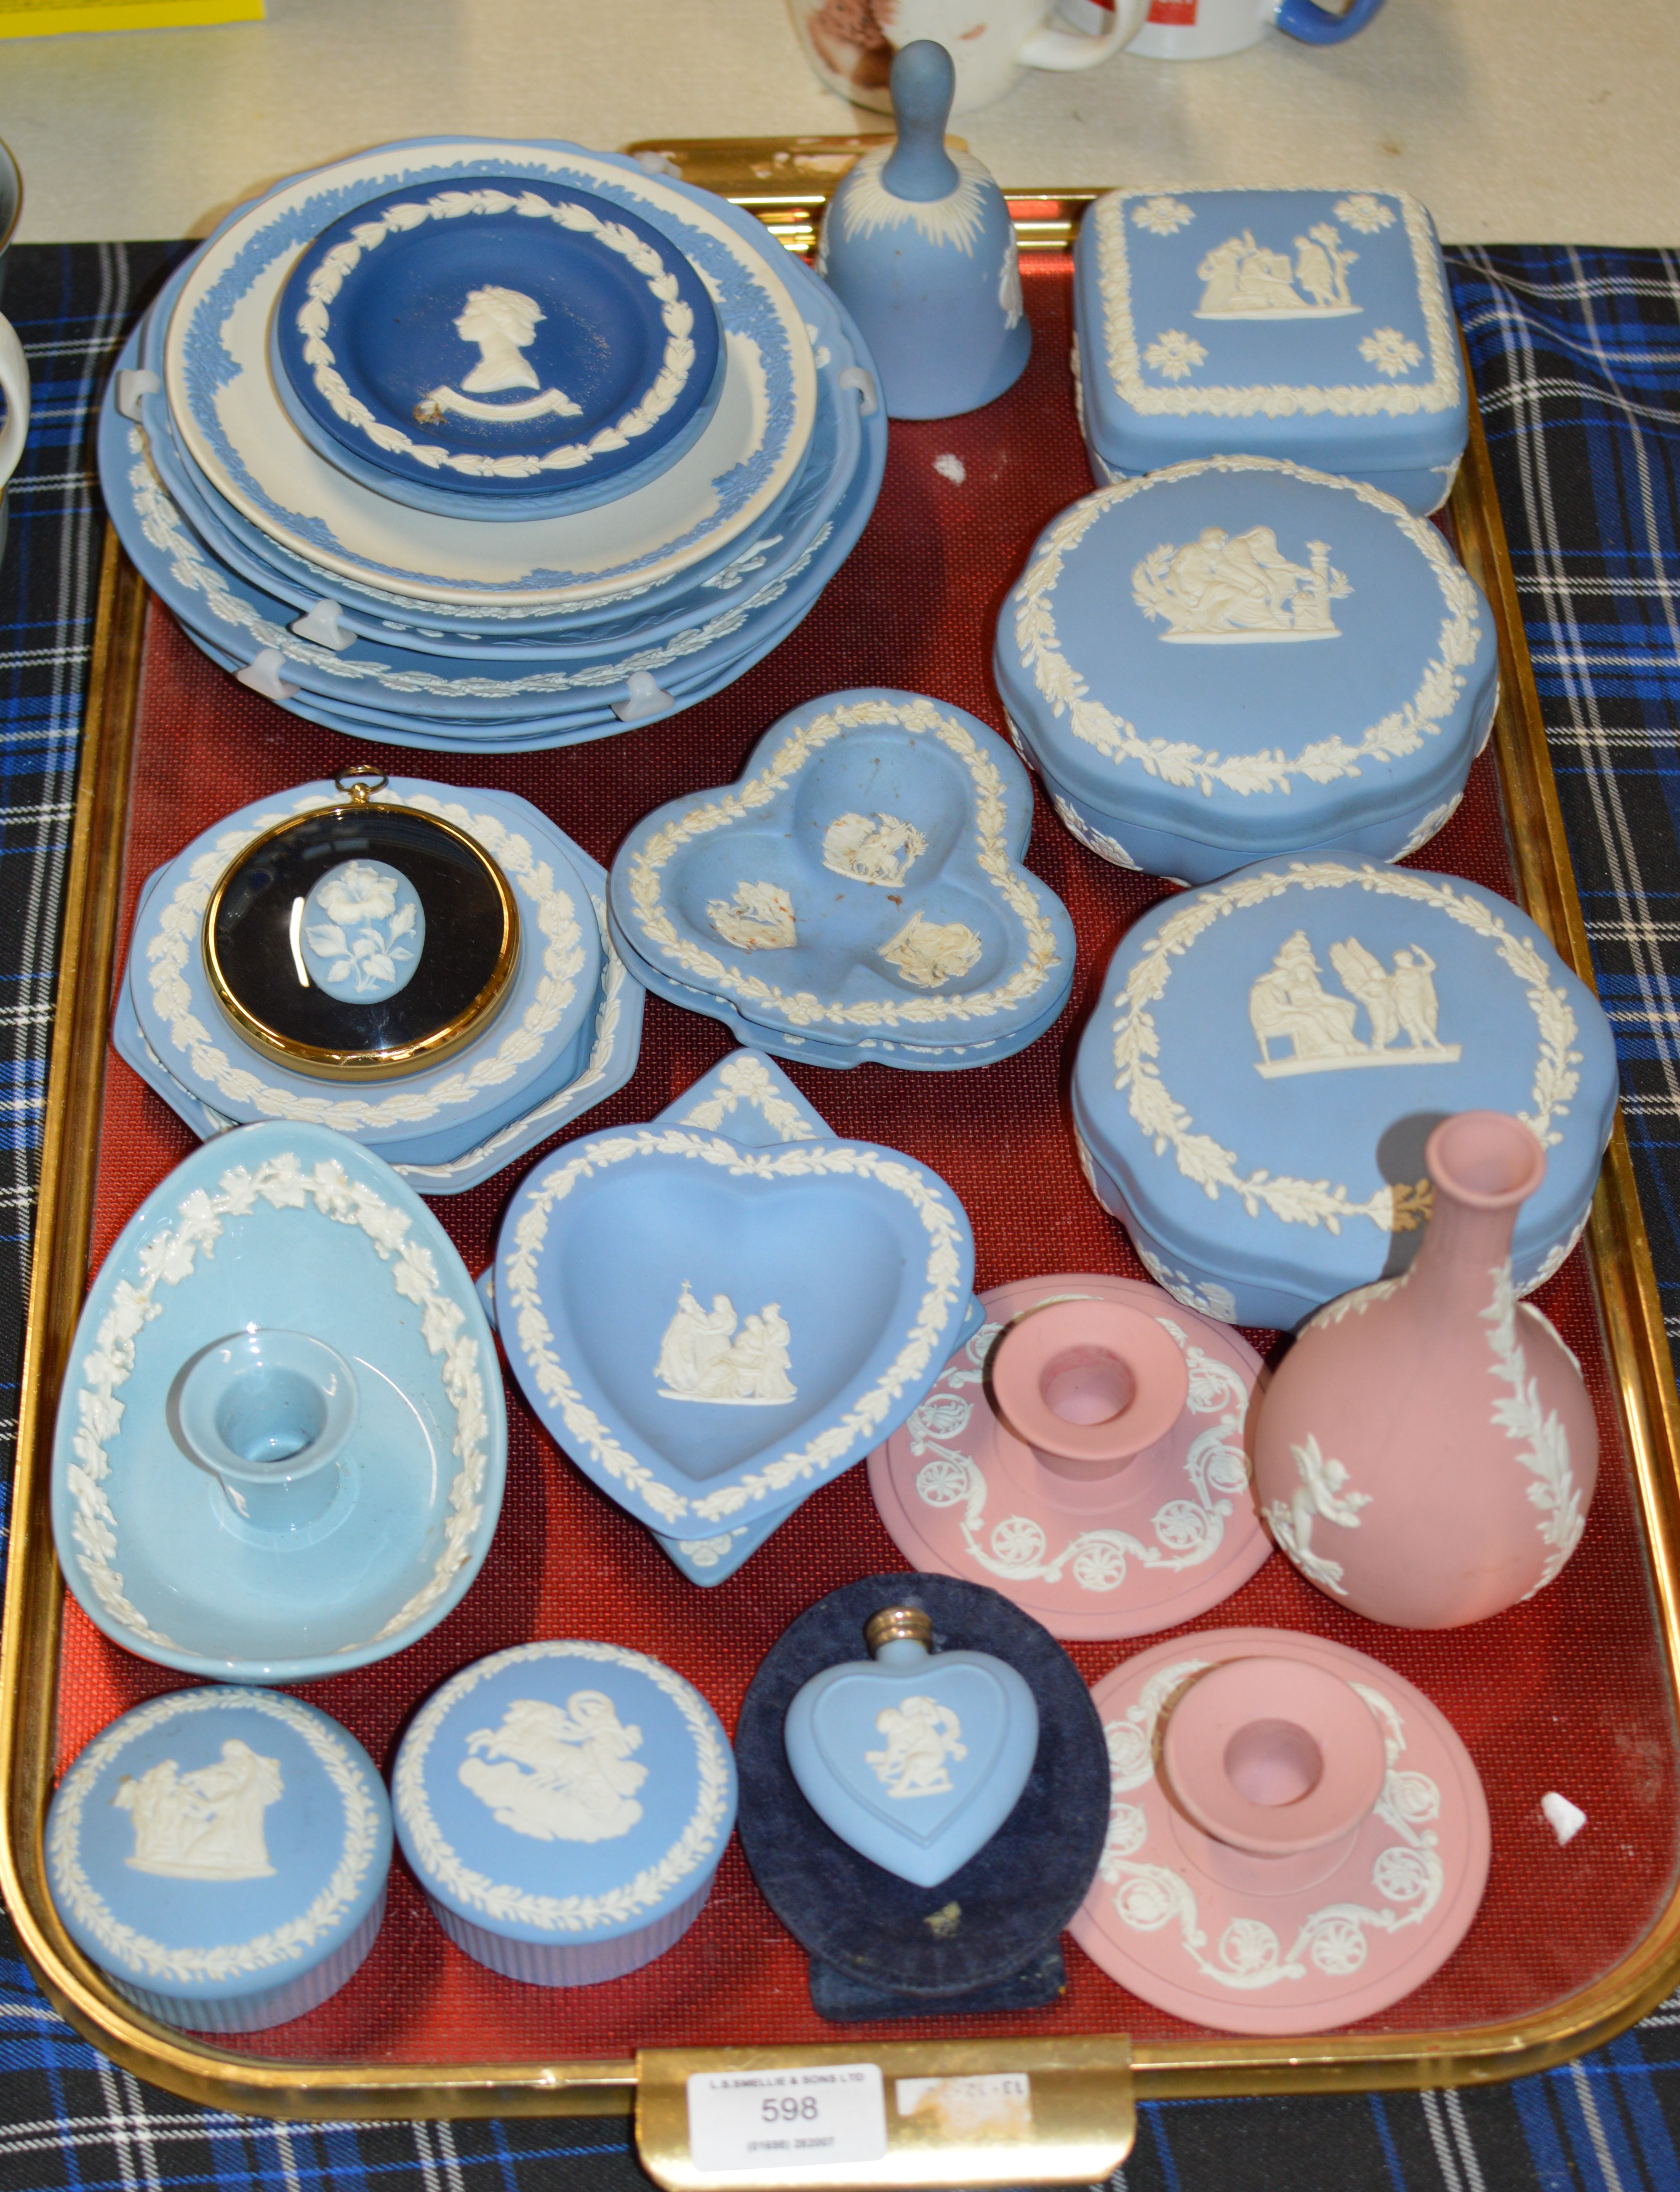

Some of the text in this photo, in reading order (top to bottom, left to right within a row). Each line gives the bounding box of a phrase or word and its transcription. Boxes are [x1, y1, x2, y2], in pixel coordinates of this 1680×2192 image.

[790, 2075, 797, 2085] &
[803, 2073, 836, 2084] SONS
[840, 2072, 865, 2082] LTD
[762, 2096, 818, 2122] 598
